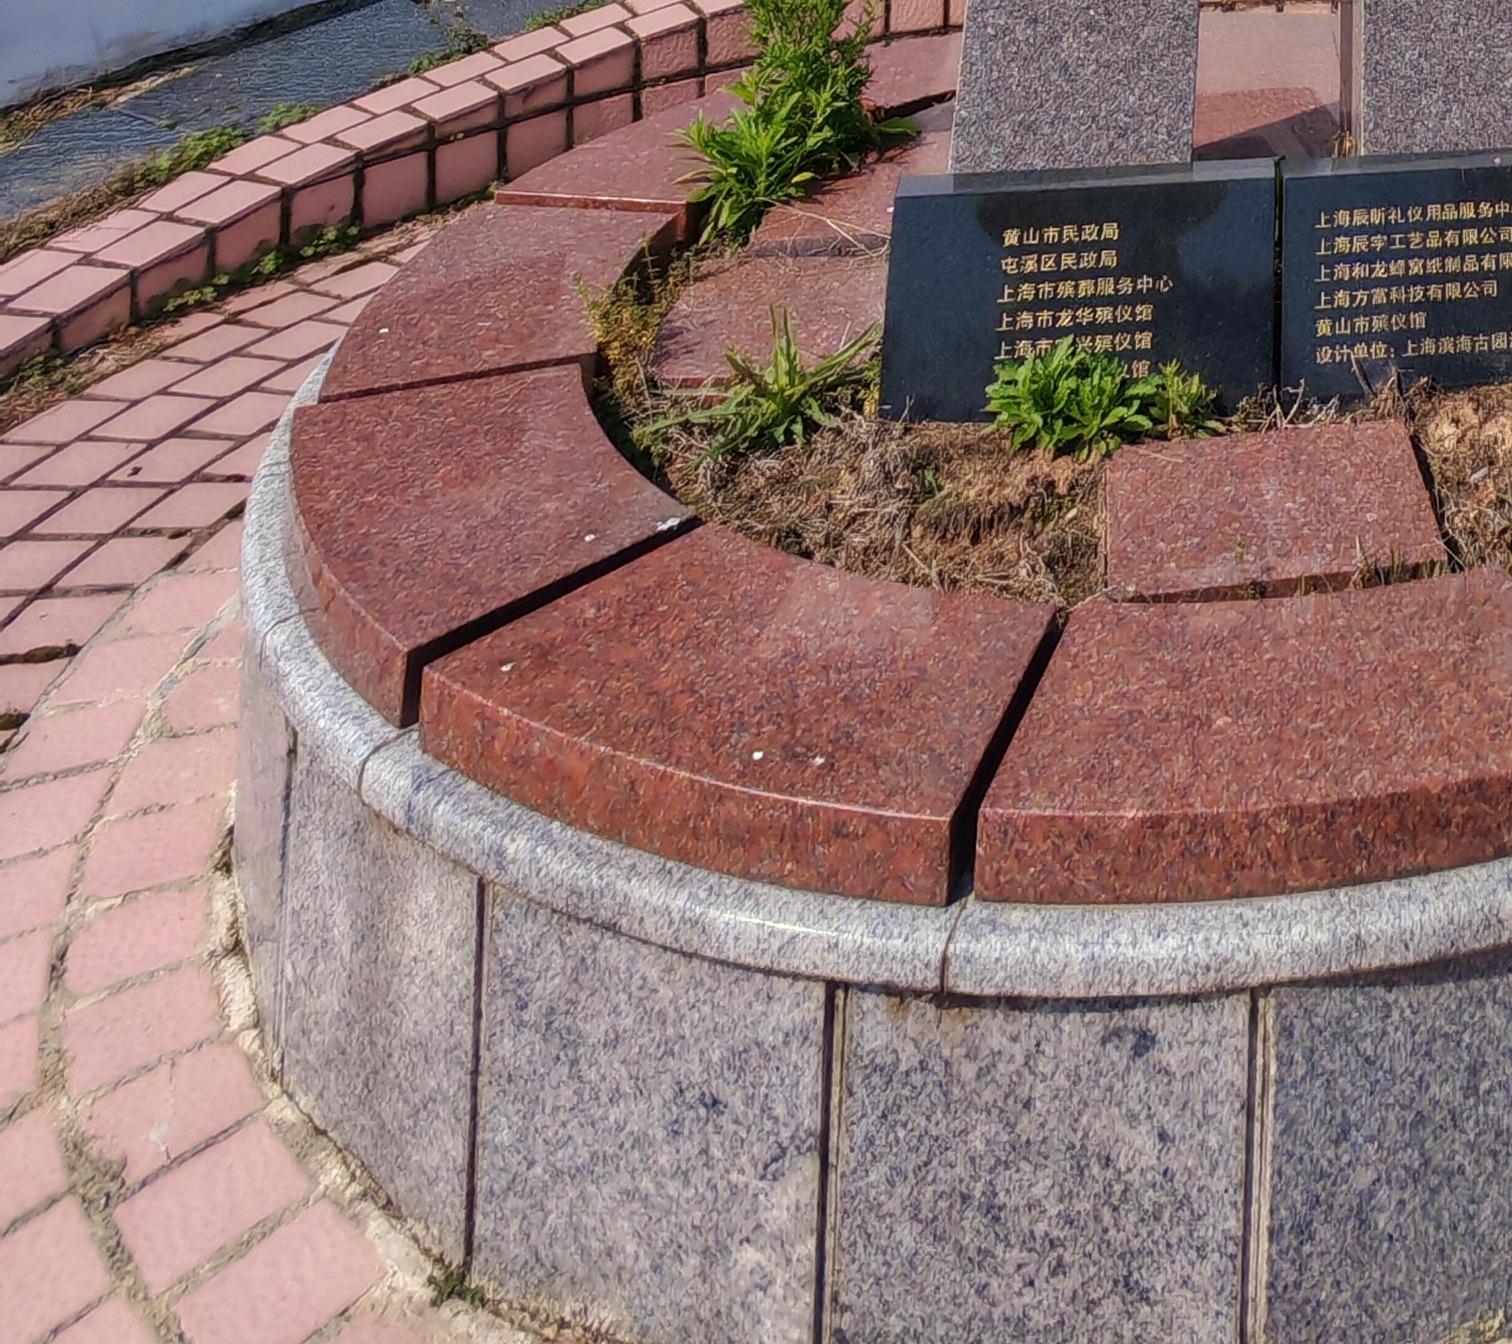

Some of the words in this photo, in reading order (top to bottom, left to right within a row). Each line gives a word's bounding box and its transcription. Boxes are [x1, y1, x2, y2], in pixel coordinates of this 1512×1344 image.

[1001, 222, 1119, 248] 黄山市民政局
[1001, 250, 1118, 275] 屯溪区民政局
[996, 273, 1174, 304] 上海市殡葬服务中心
[995, 303, 1155, 332] 上海市龙华殡仪馆
[1315, 311, 1428, 337] 黄山市殡仪馆
[994, 331, 1154, 361] 上海市兴殡仪馆
